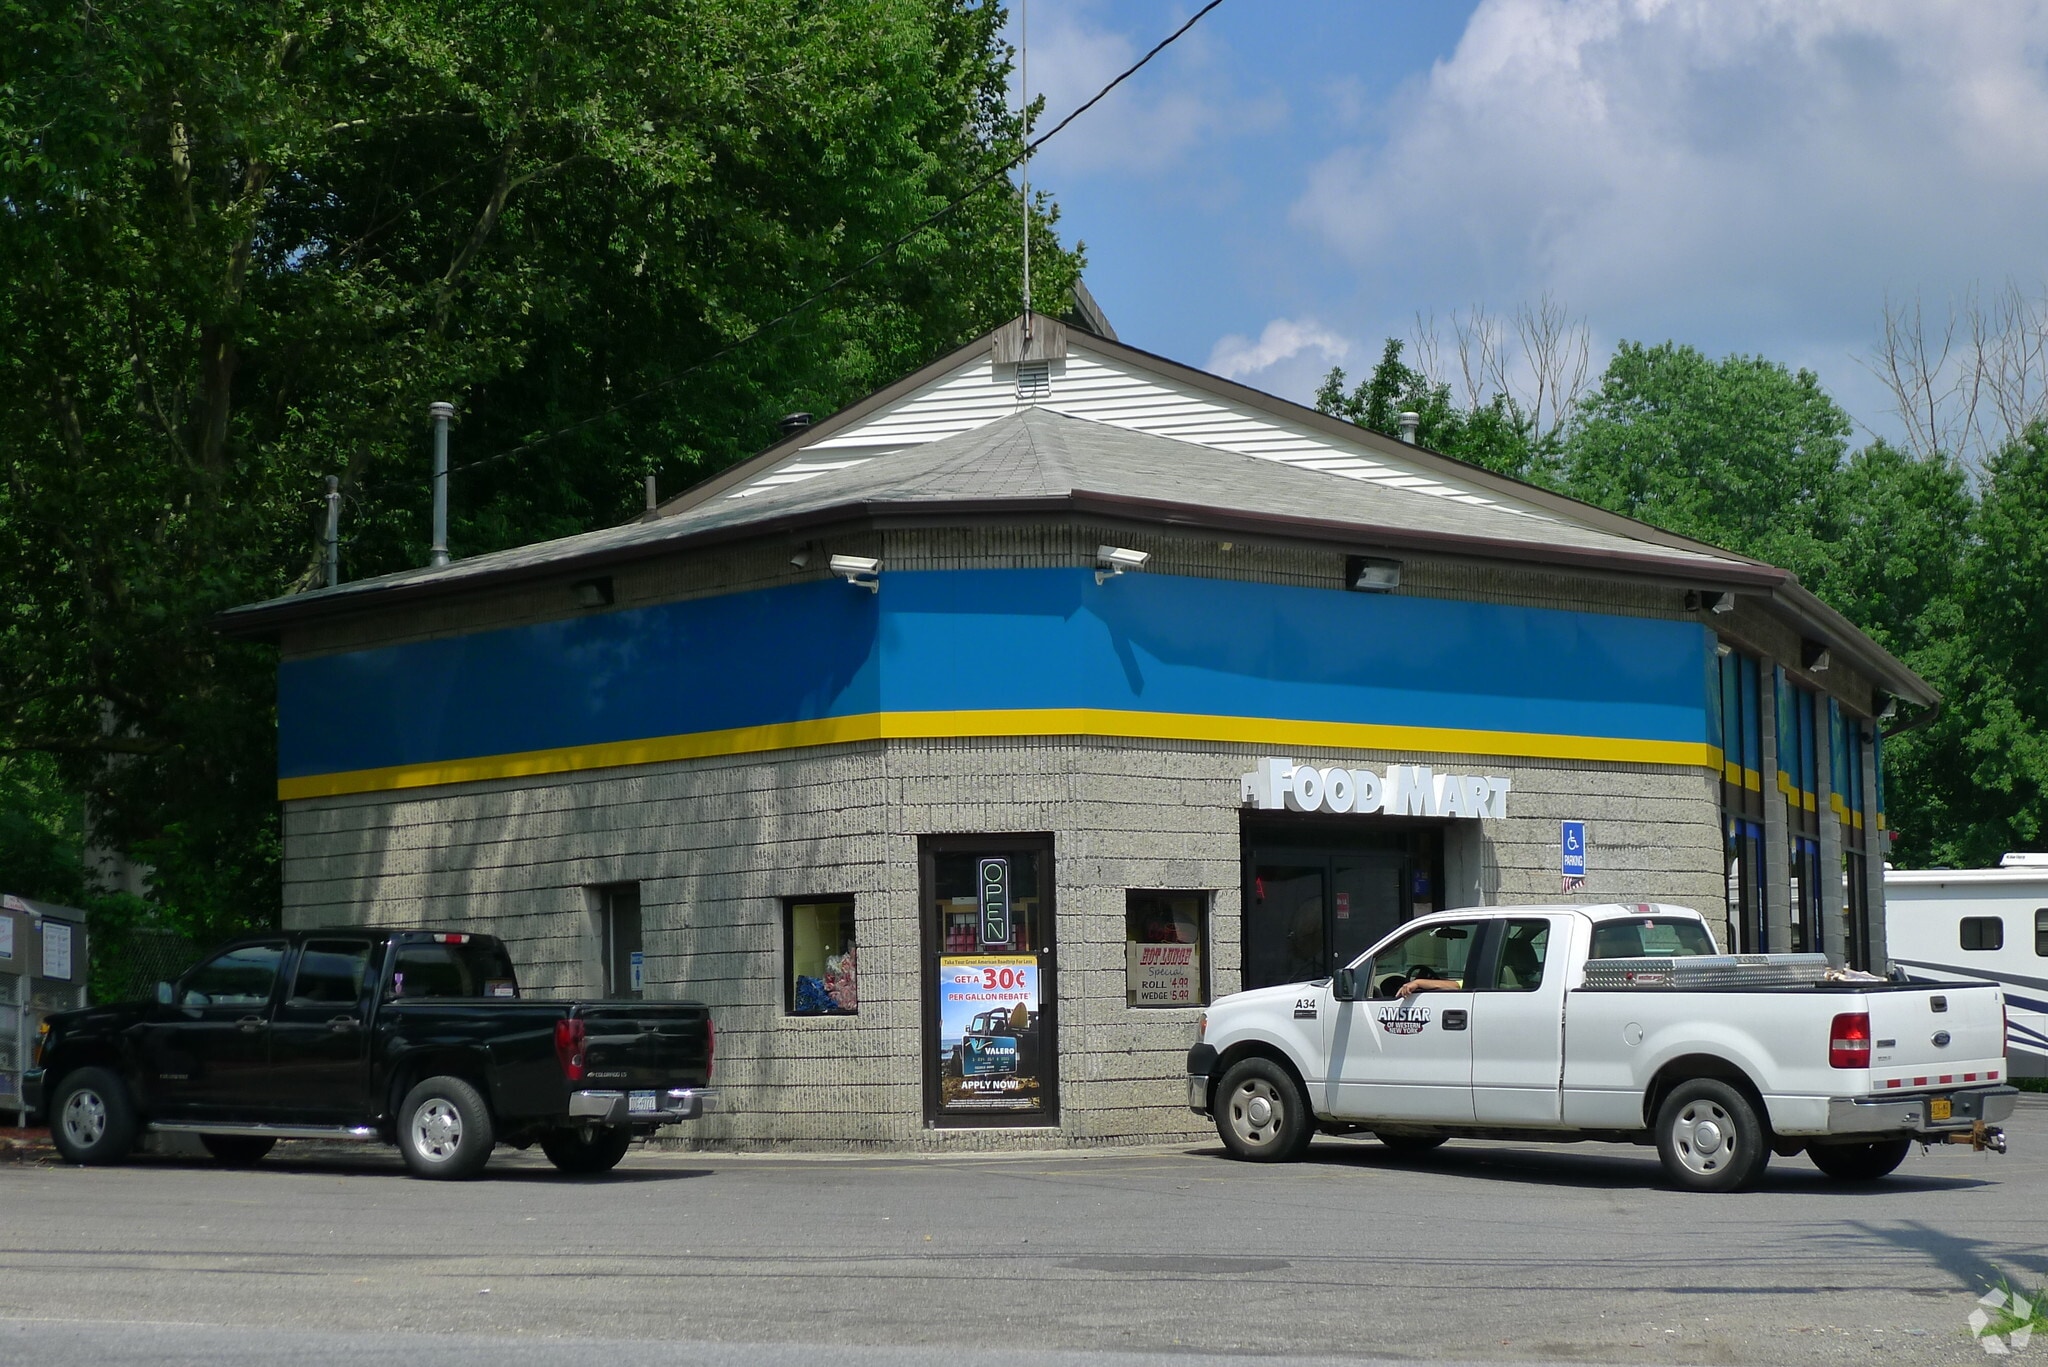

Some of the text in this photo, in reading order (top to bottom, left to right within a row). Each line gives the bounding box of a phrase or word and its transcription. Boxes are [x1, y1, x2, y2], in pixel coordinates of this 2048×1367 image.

[1258, 757, 1382, 813] FOOD
[1384, 764, 1511, 819] MART
[1564, 854, 1583, 867] PARKING
[984, 864, 1004, 939] OPEN
[1140, 947, 1162, 965] HOT
[983, 968, 1025, 989] 30¢
[1149, 966, 1184, 978] Special
[1142, 980, 1167, 988] ROLL
[1141, 992, 1168, 1000] WEDGE
[1295, 999, 1316, 1009] A34
[1377, 1006, 1430, 1021] AMSTAR
[961, 1081, 1019, 1089] APPLY NOW!
